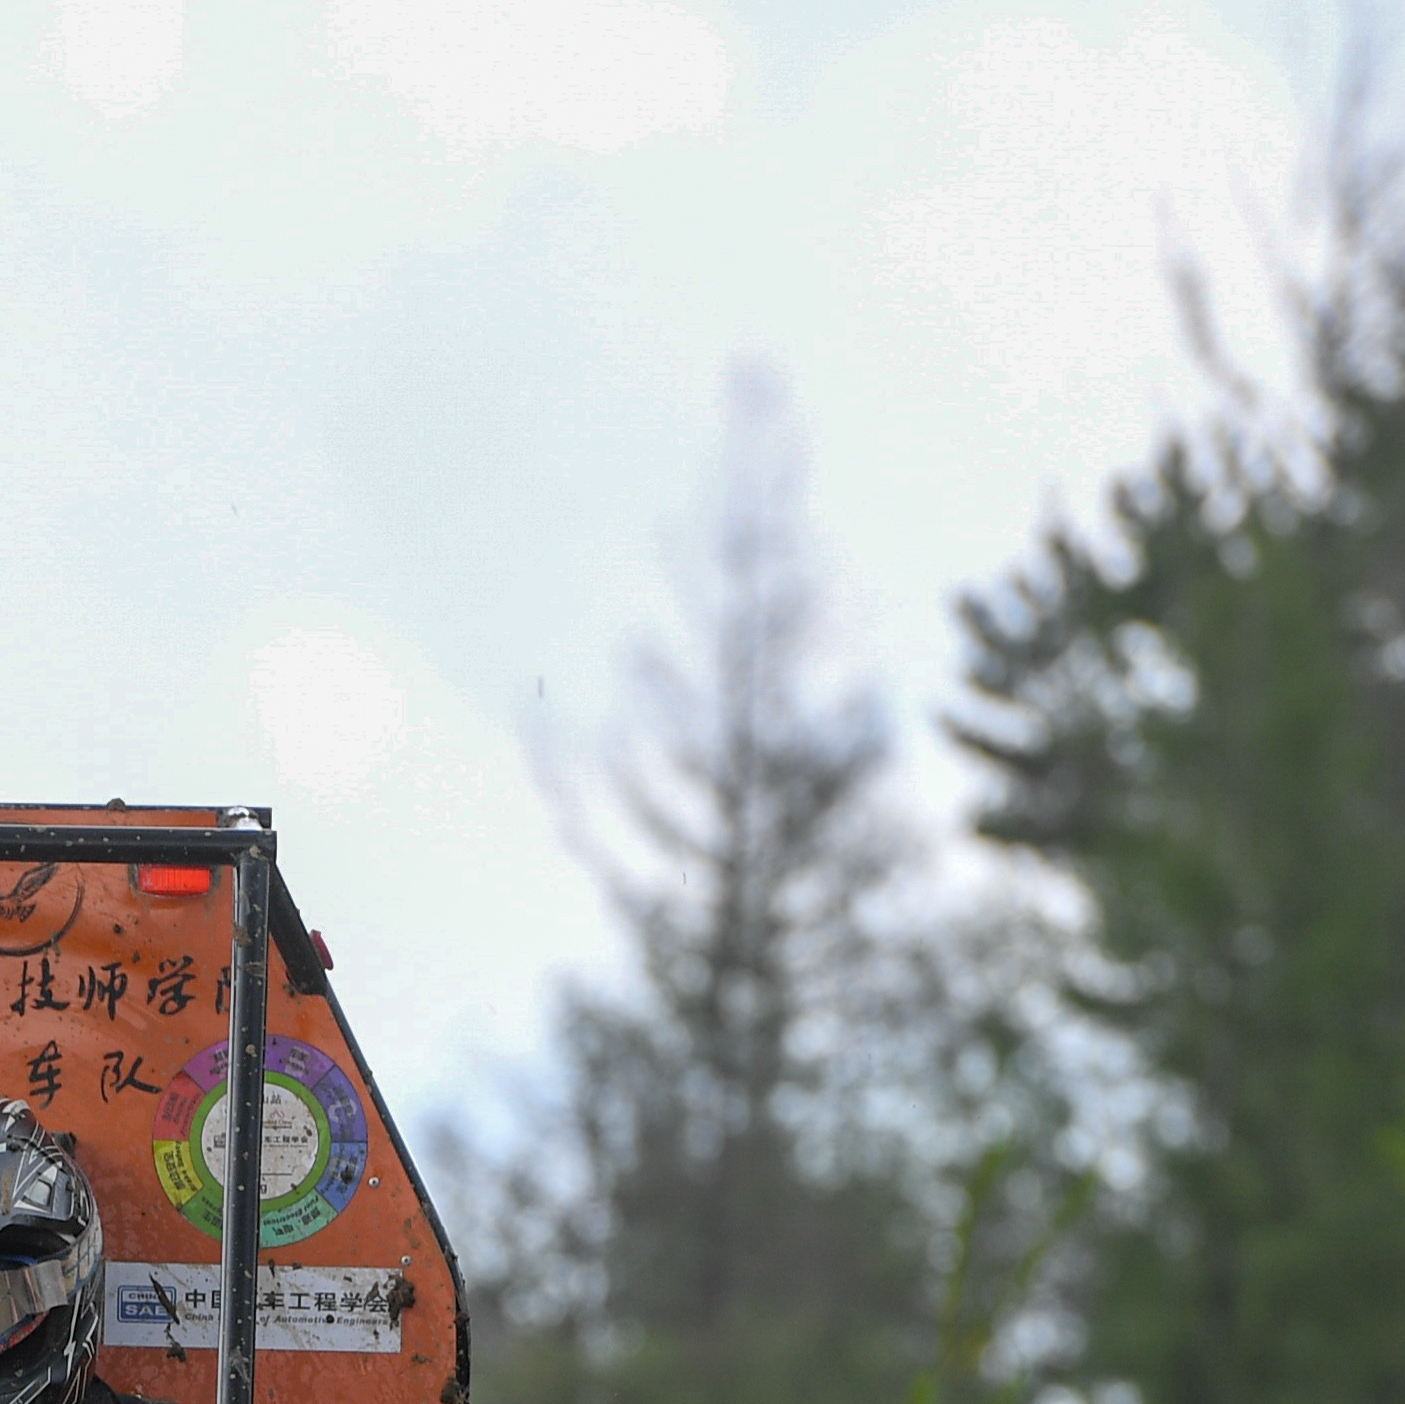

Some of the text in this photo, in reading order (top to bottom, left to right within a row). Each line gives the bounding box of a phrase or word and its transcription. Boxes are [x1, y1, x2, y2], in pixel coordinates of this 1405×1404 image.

[125, 1304, 168, 1316] SAE
[274, 1315, 333, 1324] Automotiv
[336, 1316, 389, 1325] Engineers
